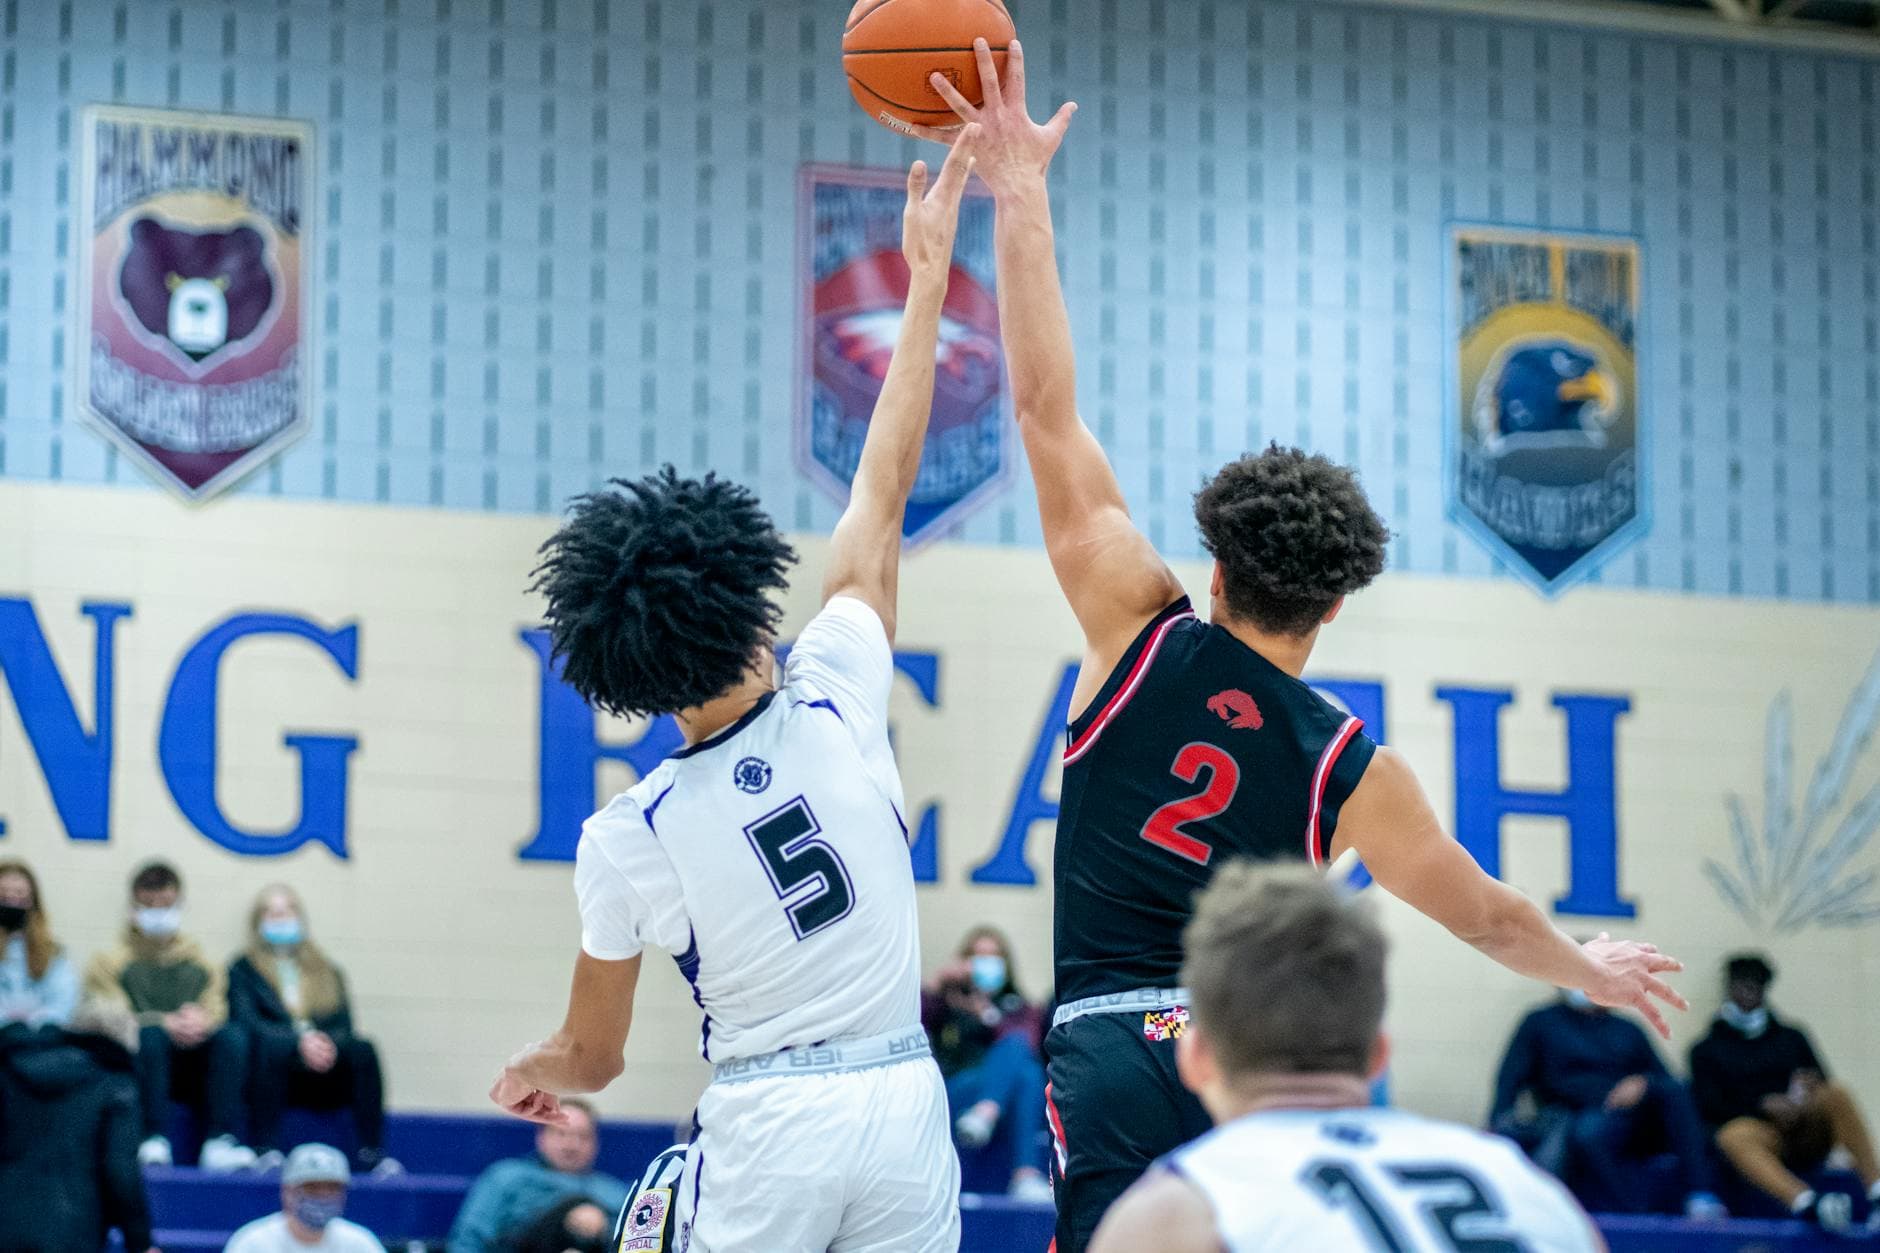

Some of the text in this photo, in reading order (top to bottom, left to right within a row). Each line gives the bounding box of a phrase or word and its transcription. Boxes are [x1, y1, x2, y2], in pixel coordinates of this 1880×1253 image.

[0, 594, 358, 860] NG
[1140, 741, 1240, 866] 2
[742, 793, 856, 942] 5
[789, 1048, 842, 1067] ER
[625, 1239, 653, 1251] OFFICIAL
[1298, 1158, 1533, 1253] 12
